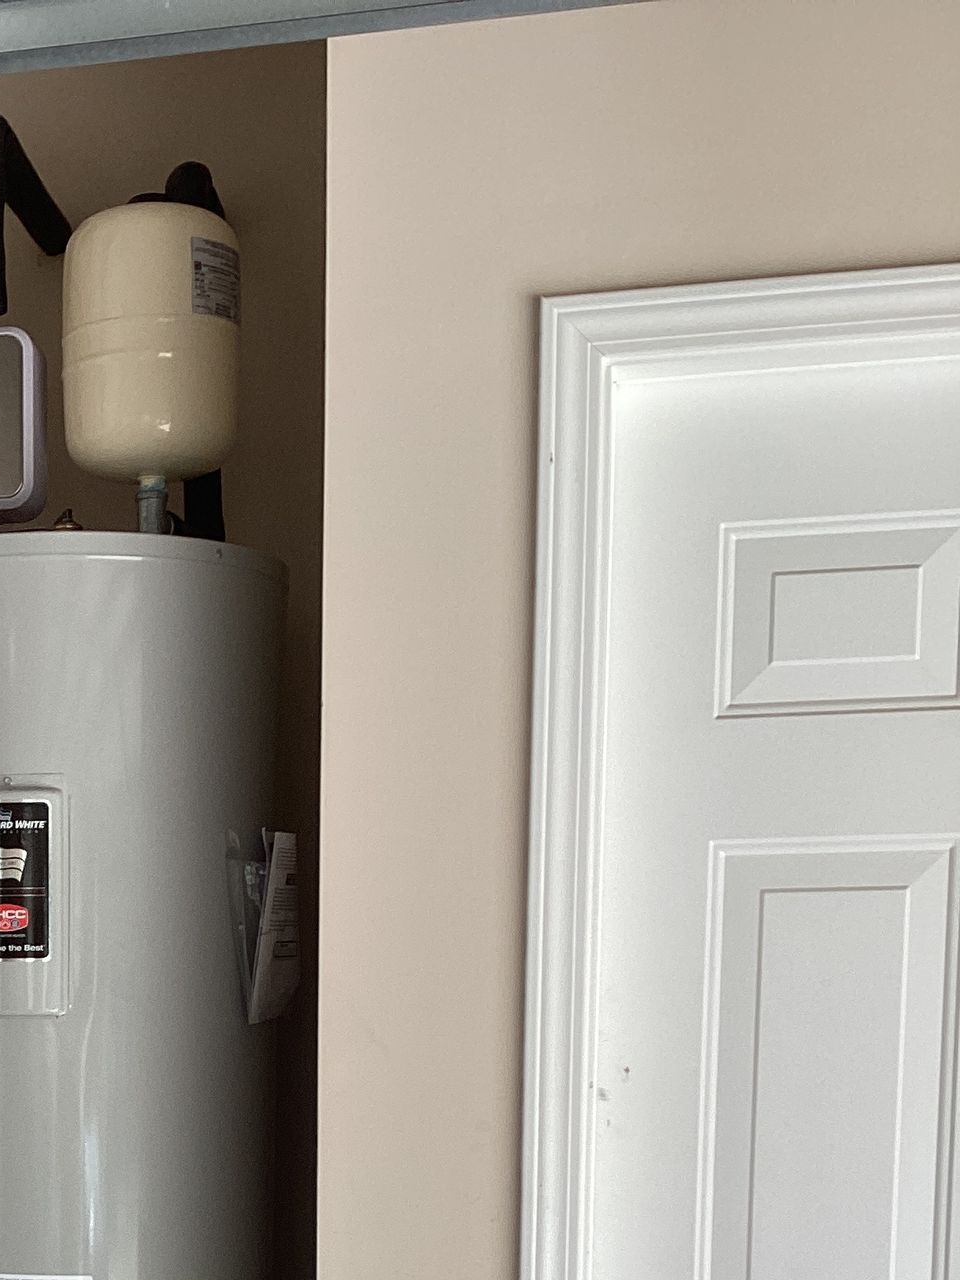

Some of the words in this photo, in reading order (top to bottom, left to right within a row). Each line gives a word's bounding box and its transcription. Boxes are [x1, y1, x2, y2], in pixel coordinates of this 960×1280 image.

[15, 820, 47, 829] WHITE
[8, 944, 22, 952] the
[23, 944, 44, 952] Best
